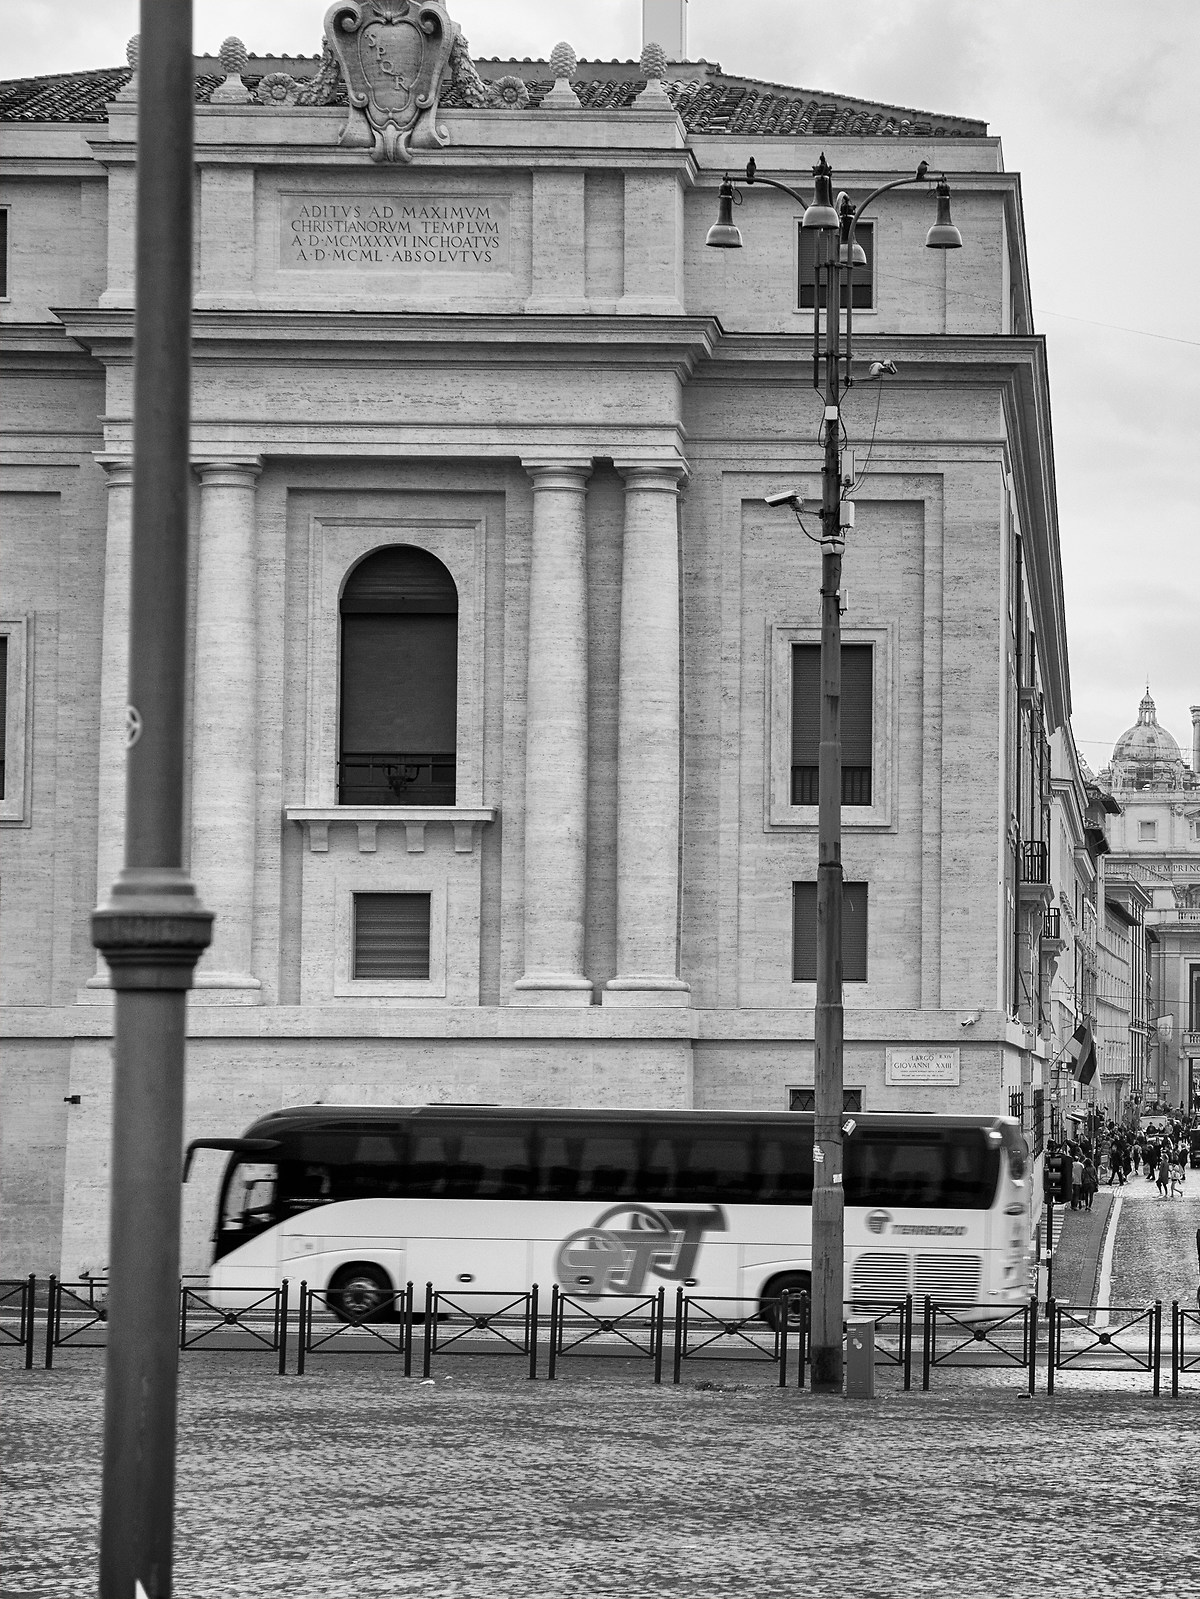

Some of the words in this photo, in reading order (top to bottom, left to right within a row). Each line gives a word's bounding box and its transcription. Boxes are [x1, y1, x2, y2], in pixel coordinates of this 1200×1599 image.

[299, 205, 361, 218] ADITVS
[368, 206, 394, 218] AD
[401, 206, 491, 219] MAXIMVM
[291, 220, 411, 233] CHRISTIANORVM
[421, 221, 500, 234] TEMPLVM
[413, 235, 500, 248] INCHOATVS
[391, 250, 492, 262] ABSOLVTVS
